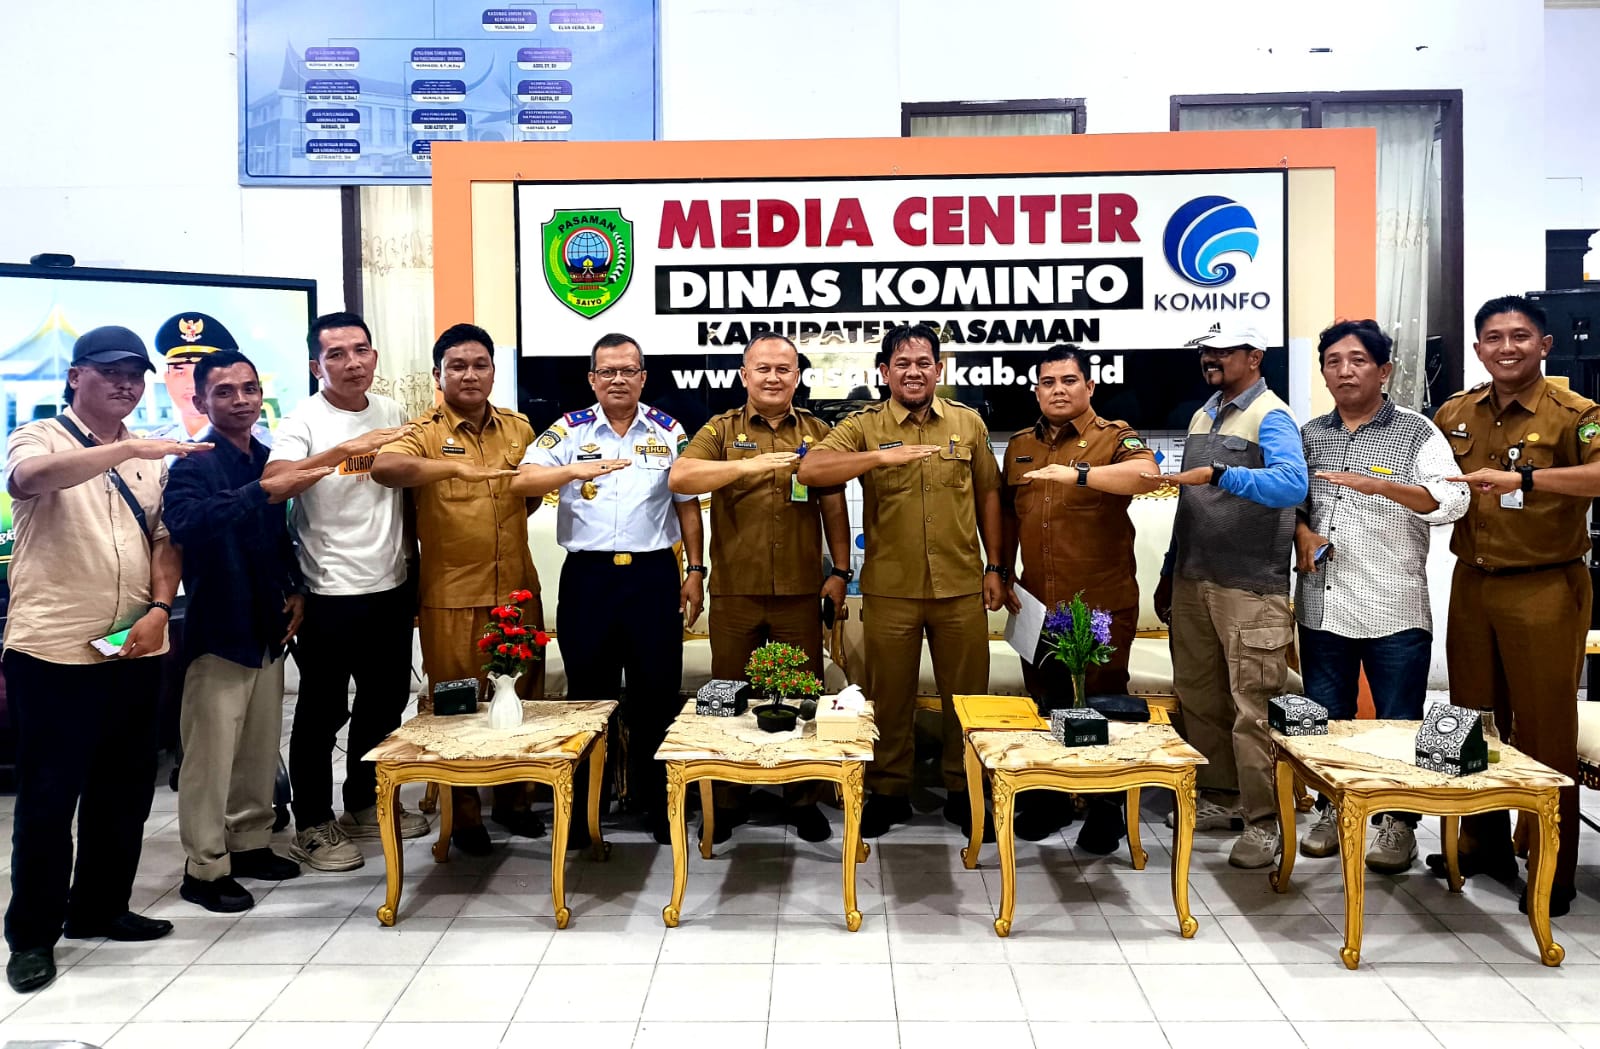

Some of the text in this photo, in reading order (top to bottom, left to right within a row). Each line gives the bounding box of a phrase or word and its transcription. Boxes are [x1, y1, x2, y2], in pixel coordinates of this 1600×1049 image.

[558, 215, 616, 233] PASAMAN
[658, 193, 1140, 249] MEDIA CENTER
[669, 264, 1129, 309] DINAS KOMINFO
[576, 298, 602, 306] SAIYO
[1154, 291, 1271, 312] KOMINFO
[636, 446, 668, 454] DSHUB
[344, 454, 377, 472] JOURNA
